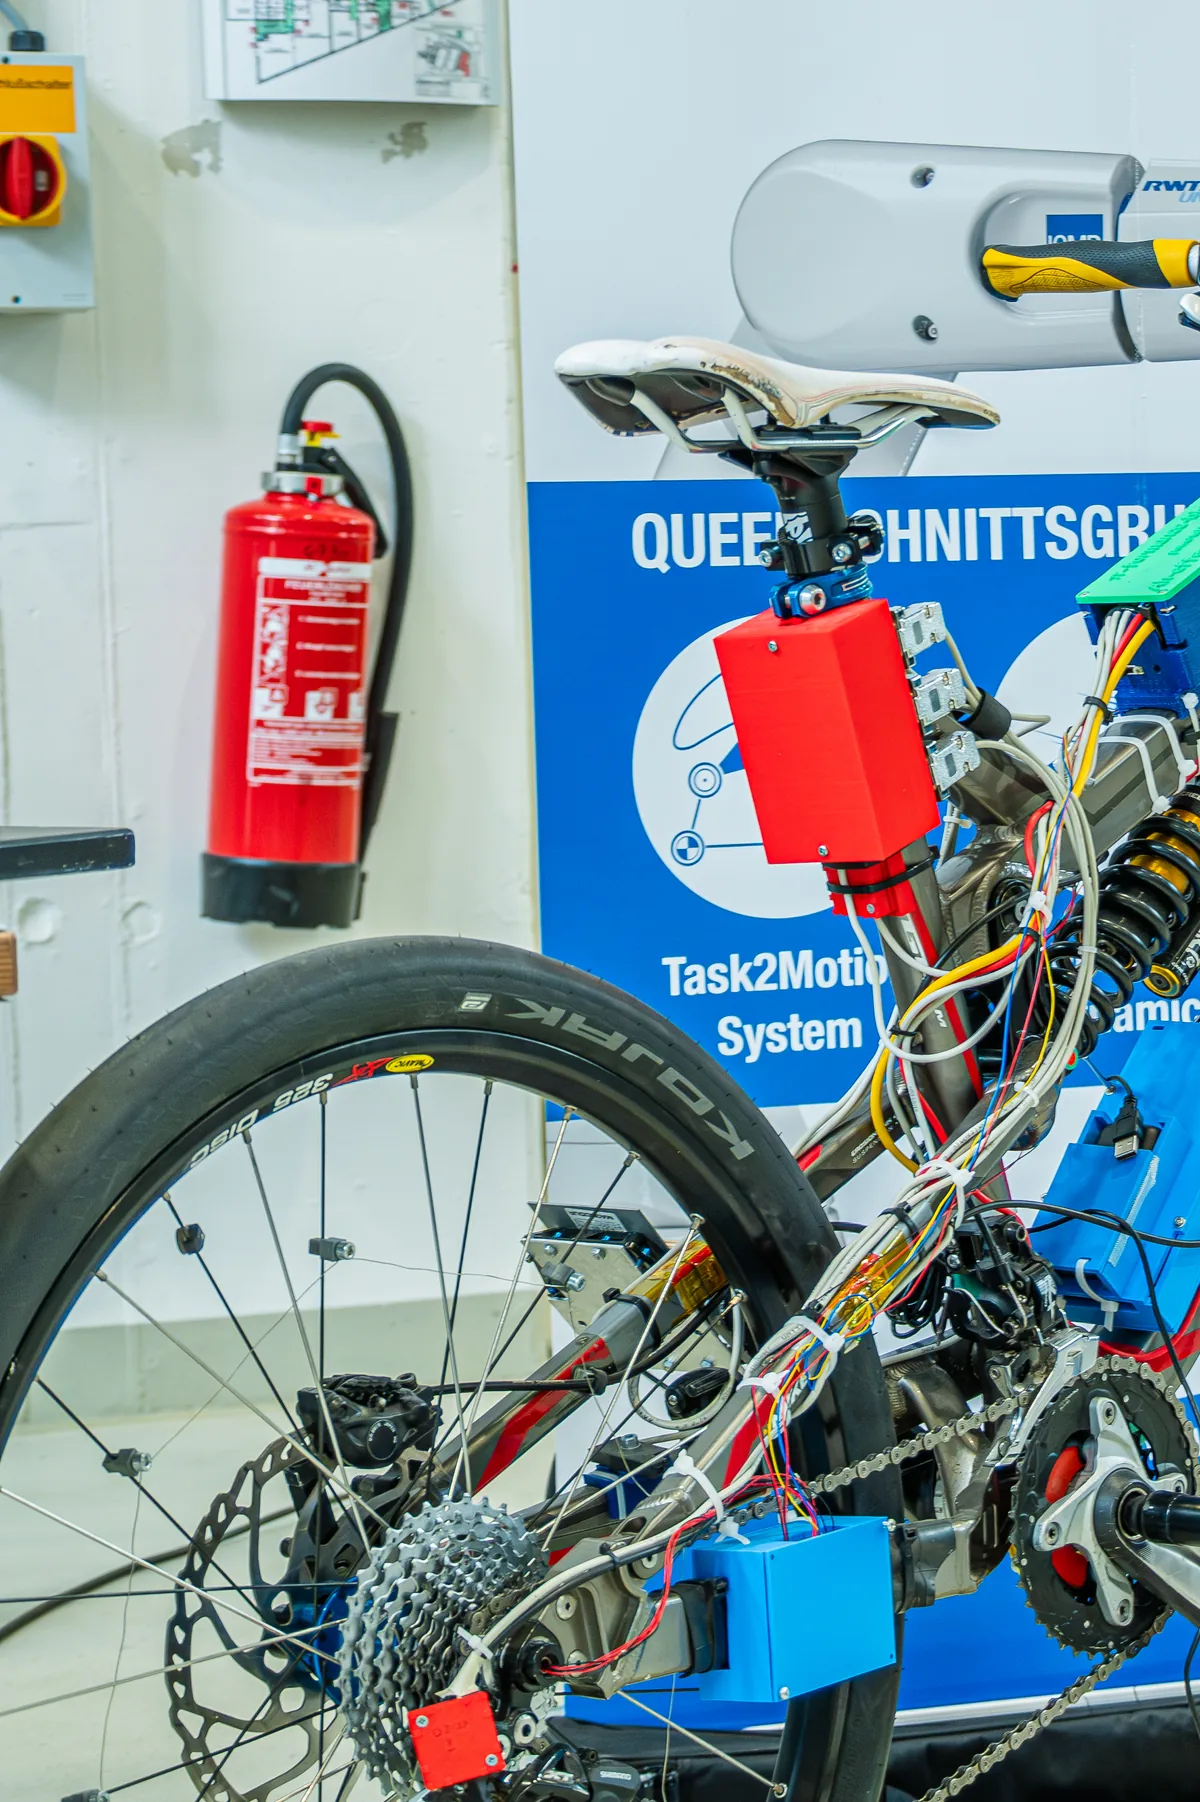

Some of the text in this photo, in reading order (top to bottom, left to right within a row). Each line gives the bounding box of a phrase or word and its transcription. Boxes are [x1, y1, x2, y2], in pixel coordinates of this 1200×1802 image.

[661, 946, 889, 996] Task2Motio
[717, 1013, 863, 1063] System
[272, 1073, 334, 1113] 325
[504, 998, 755, 1161] KOJAK
[189, 1108, 260, 1169] DISC
